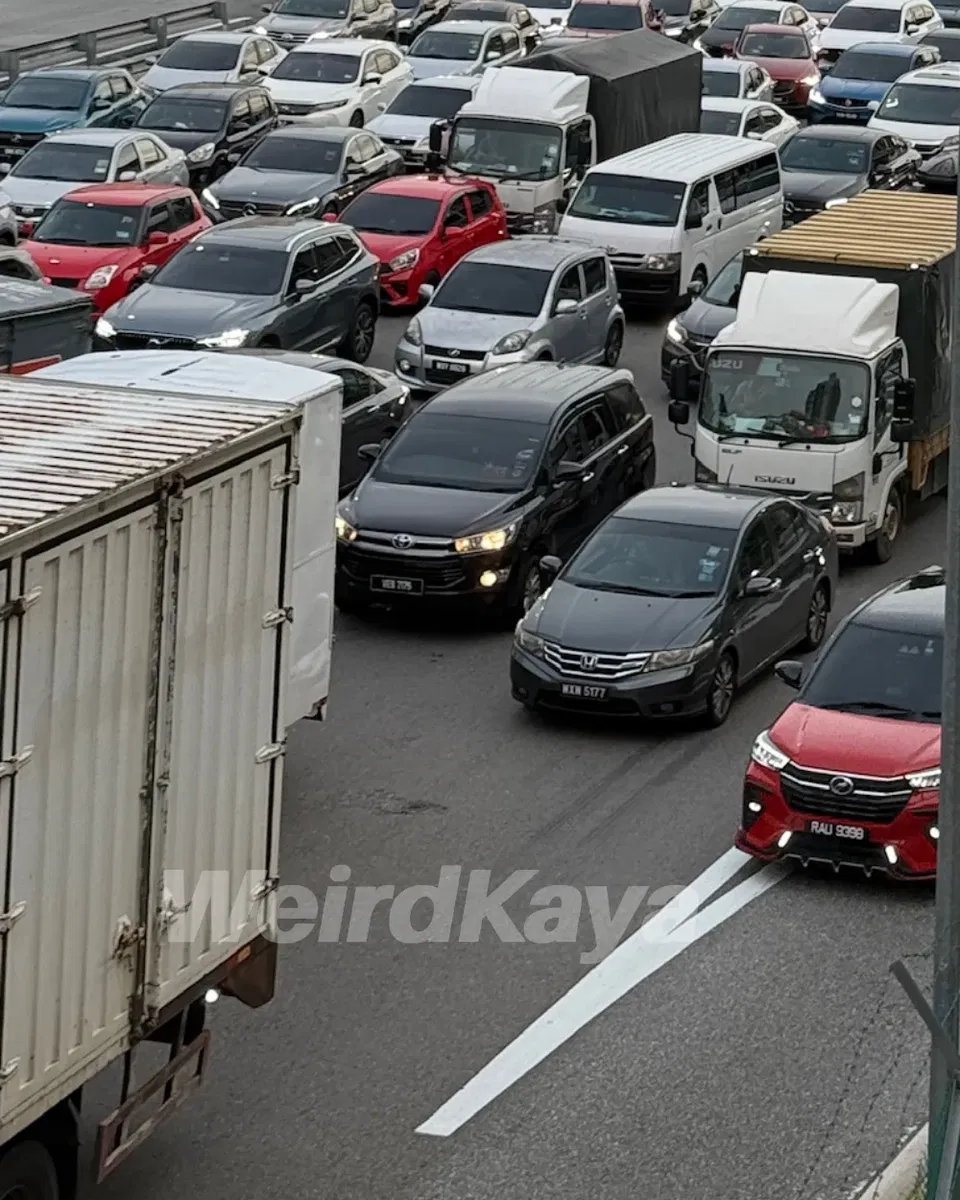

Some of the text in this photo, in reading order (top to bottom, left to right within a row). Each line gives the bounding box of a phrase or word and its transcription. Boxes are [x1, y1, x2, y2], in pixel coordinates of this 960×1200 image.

[754, 475, 796, 485] ISUZU
[583, 685, 606, 699] 5177
[811, 820, 865, 840] RAU 9398
